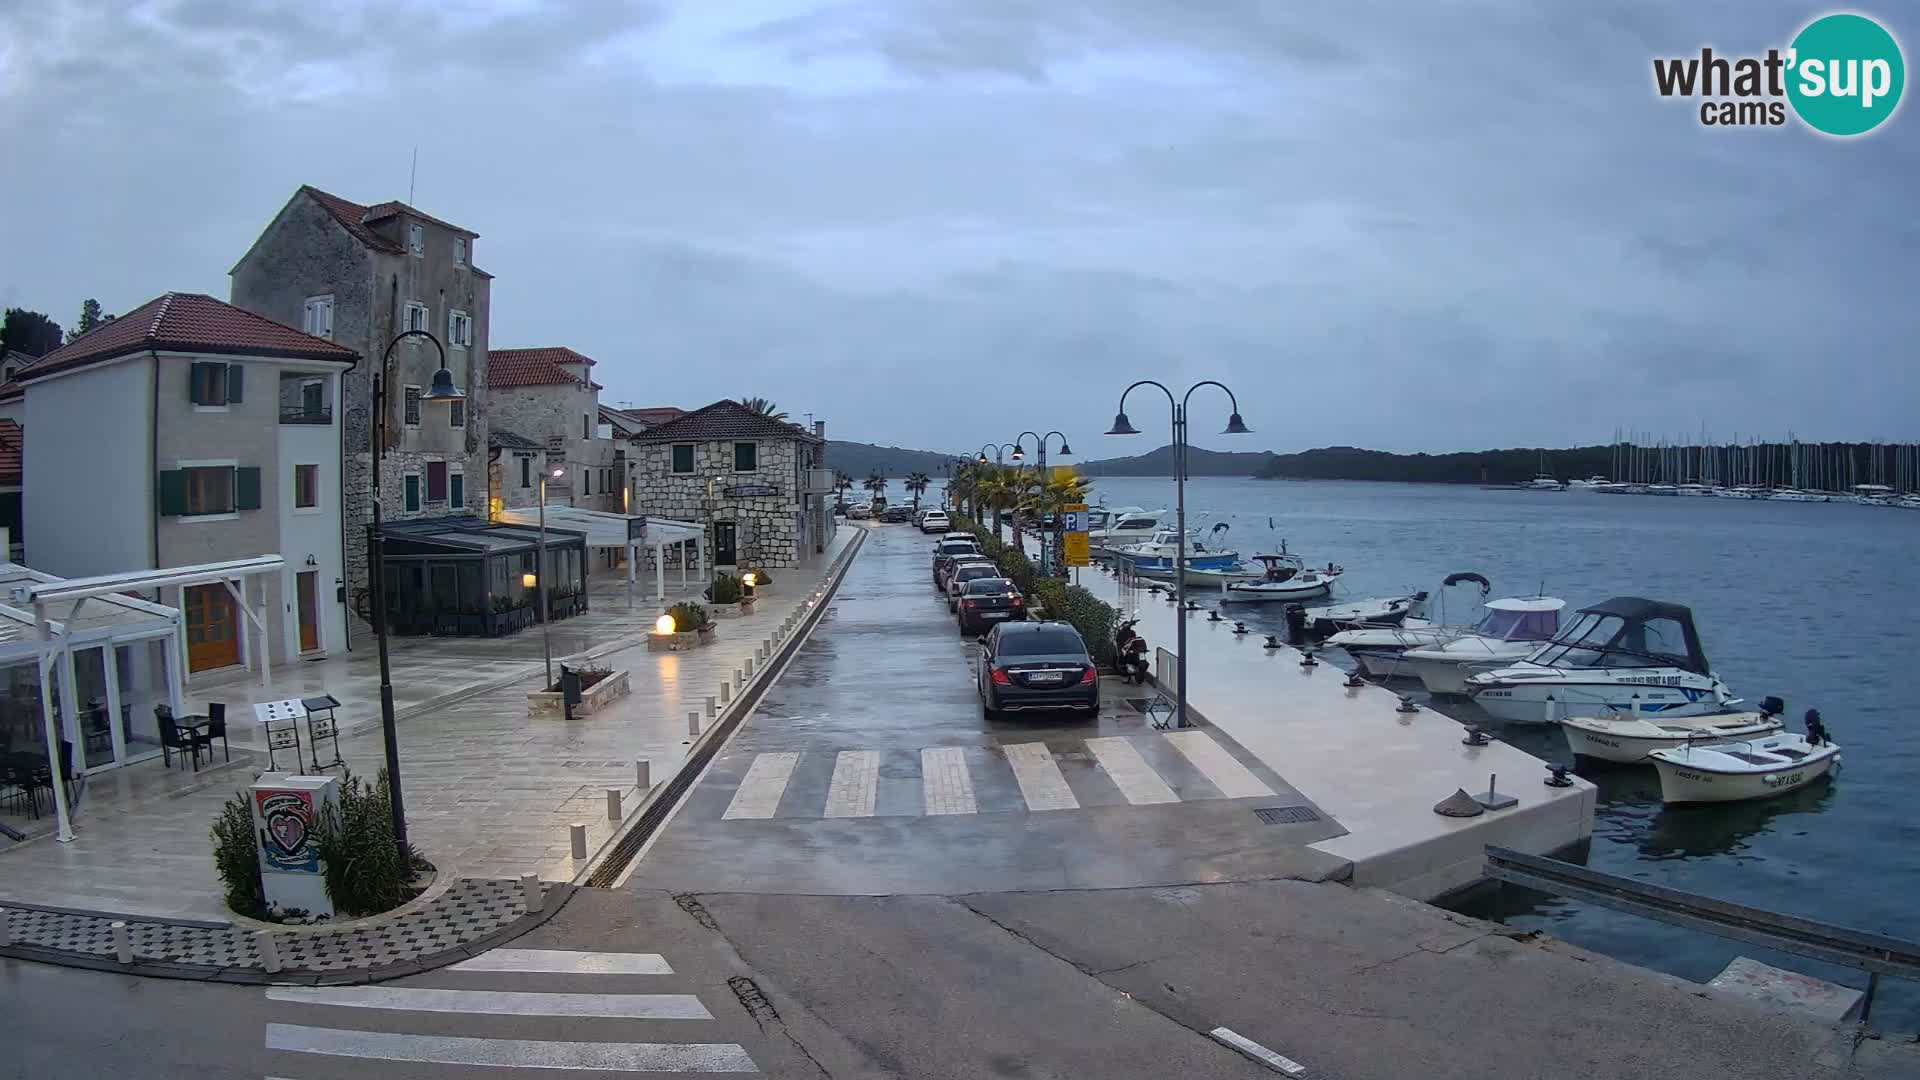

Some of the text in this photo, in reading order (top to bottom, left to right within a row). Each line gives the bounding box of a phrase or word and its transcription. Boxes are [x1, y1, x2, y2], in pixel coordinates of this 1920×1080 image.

[1065, 513, 1076, 530] P
[1645, 676, 1661, 686] RENT
[1667, 675, 1682, 686] BOAT
